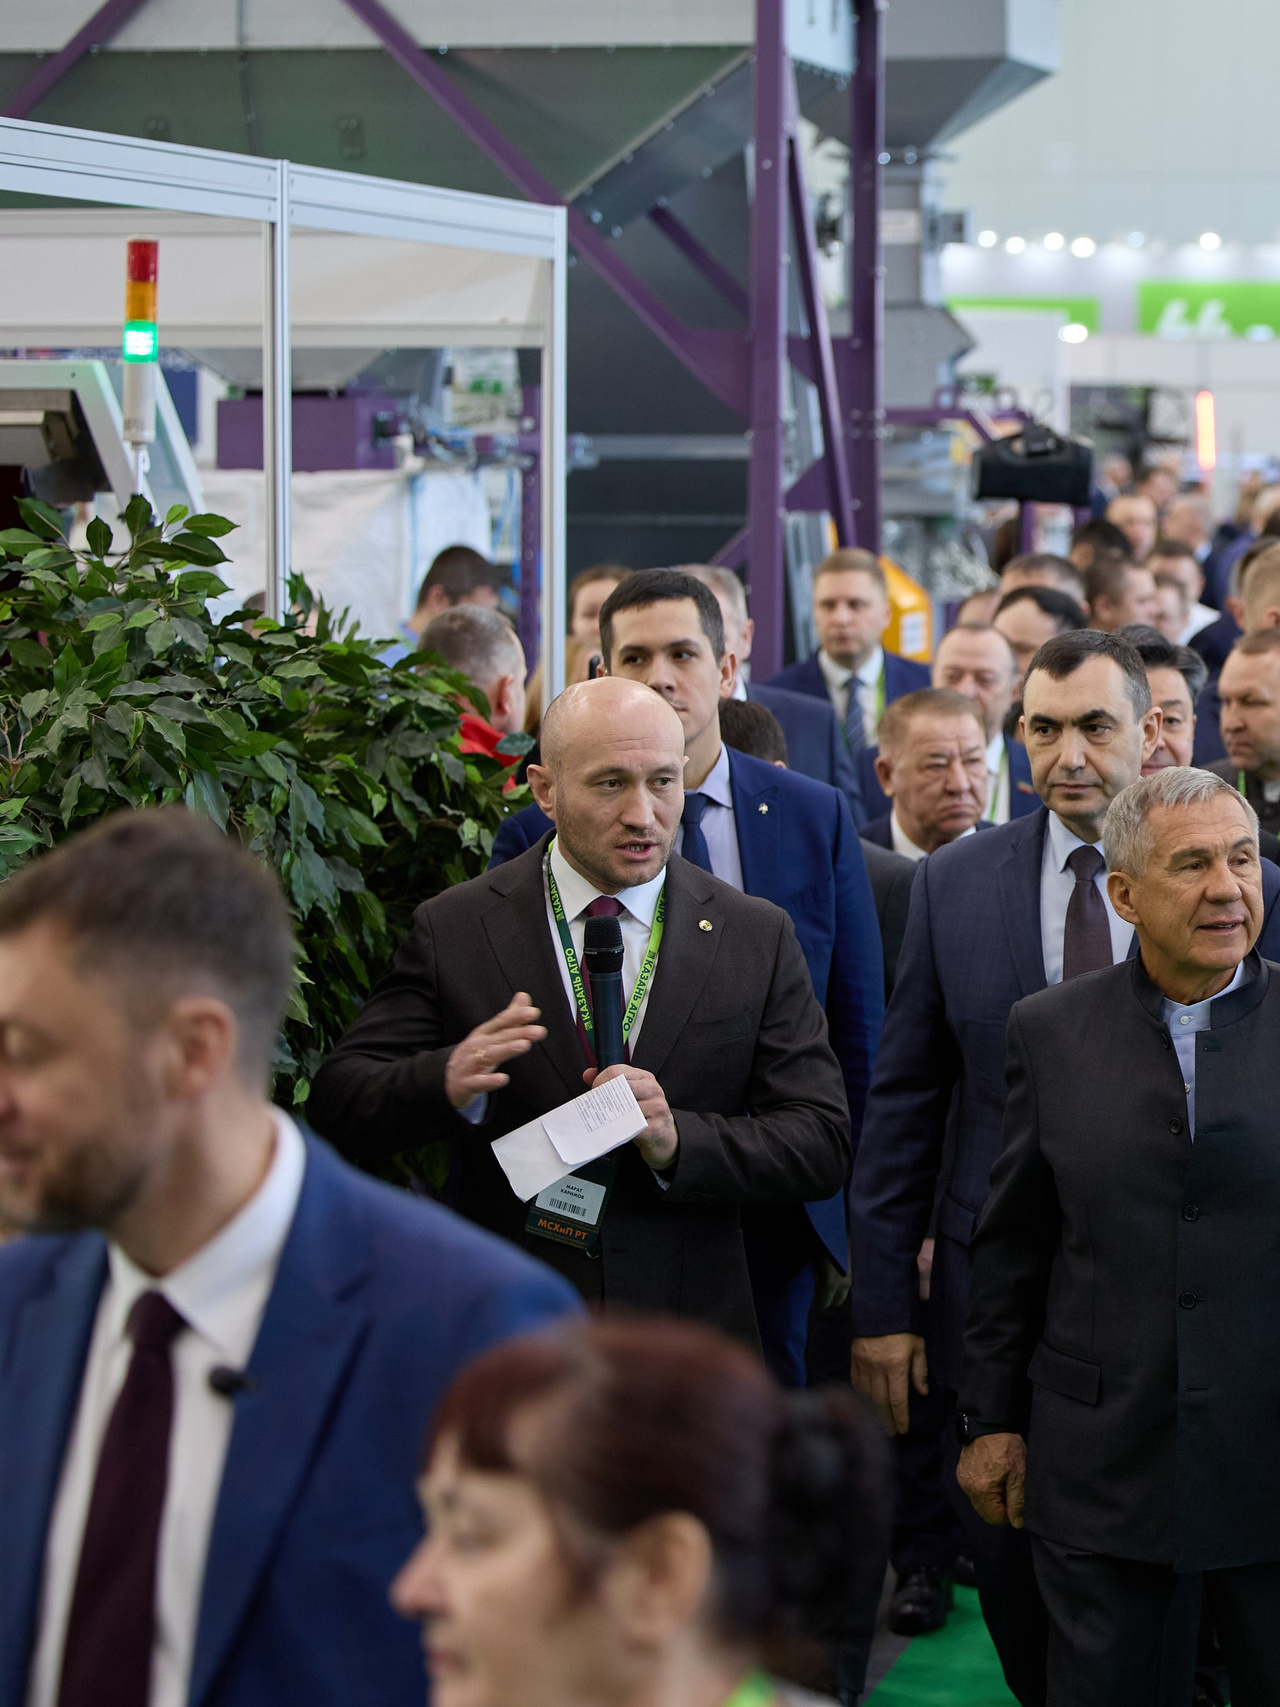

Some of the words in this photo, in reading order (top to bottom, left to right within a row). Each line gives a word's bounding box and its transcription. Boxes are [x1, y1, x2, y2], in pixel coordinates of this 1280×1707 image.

[565, 947, 580, 974] АГРО
[633, 959, 654, 1002] КАЗАНЬ
[573, 976, 591, 1021] КАЗАНЬ
[623, 1003, 638, 1032] АГРО
[560, 1189, 585, 1200] КАРИМОВ
[566, 1184, 583, 1193] МАРАТ
[537, 1218, 573, 1237] МСХиП
[574, 1230, 588, 1240] РТ
